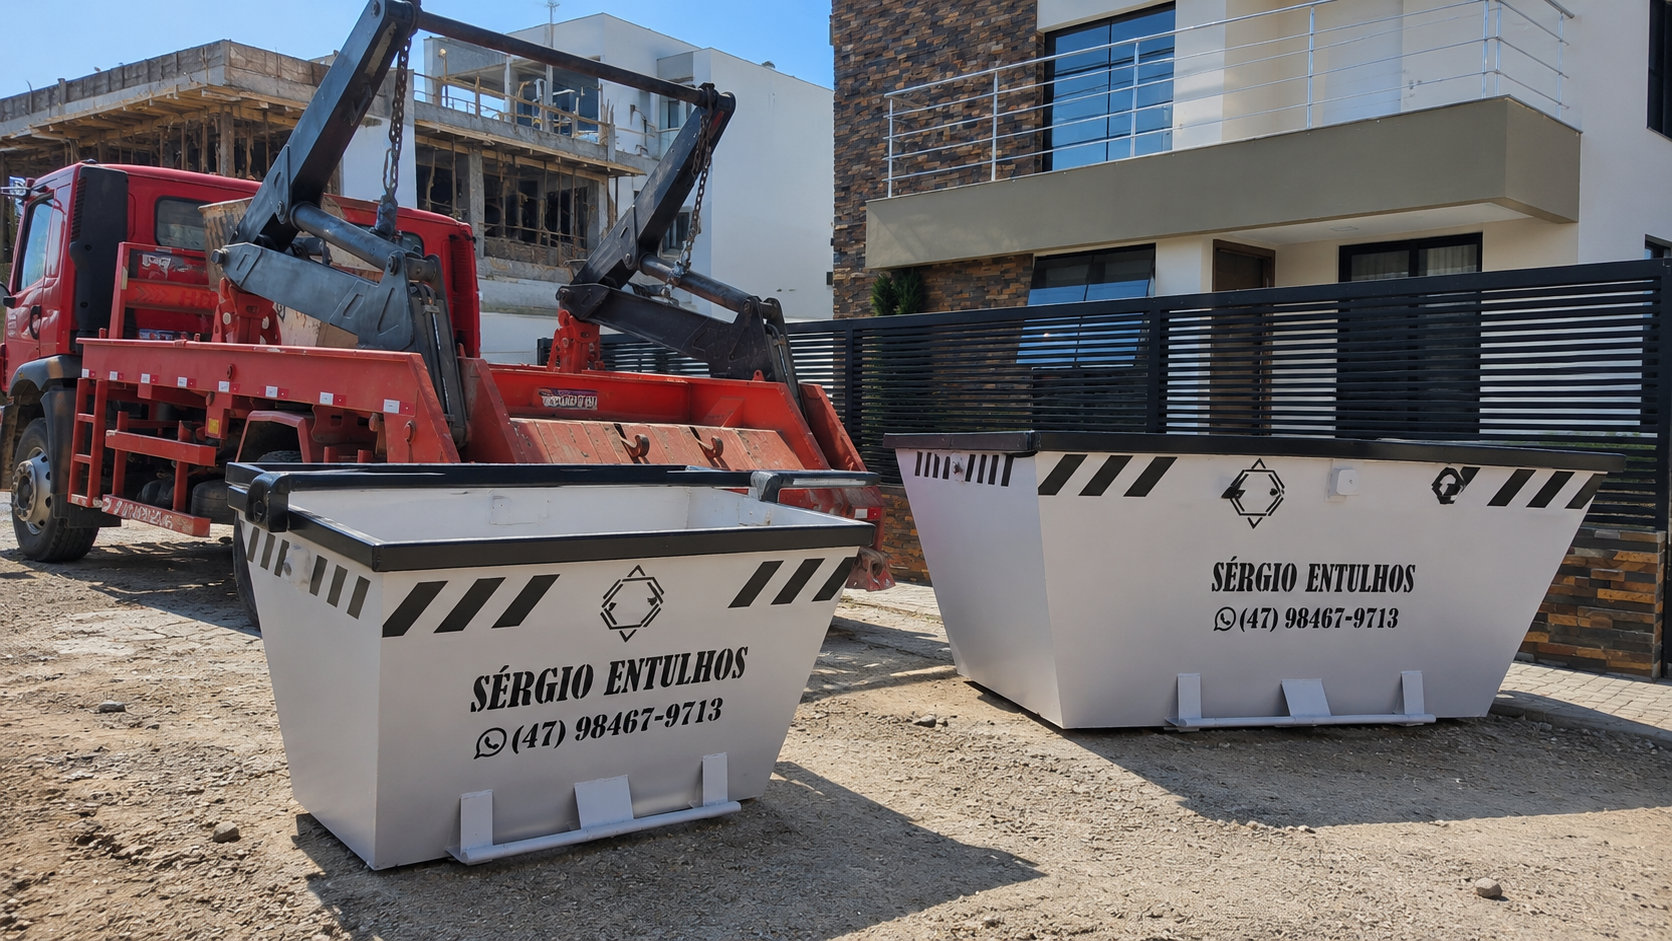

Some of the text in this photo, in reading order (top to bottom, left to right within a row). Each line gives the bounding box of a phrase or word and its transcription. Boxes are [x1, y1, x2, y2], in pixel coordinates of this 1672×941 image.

[1211, 555, 1416, 593] SÉRGIO ENTULHOS
[1239, 607, 1400, 632] (47) 98467-9713
[470, 646, 749, 713] SÉRGIO ENTULHOS
[511, 697, 723, 754] (47) 98467-9713
